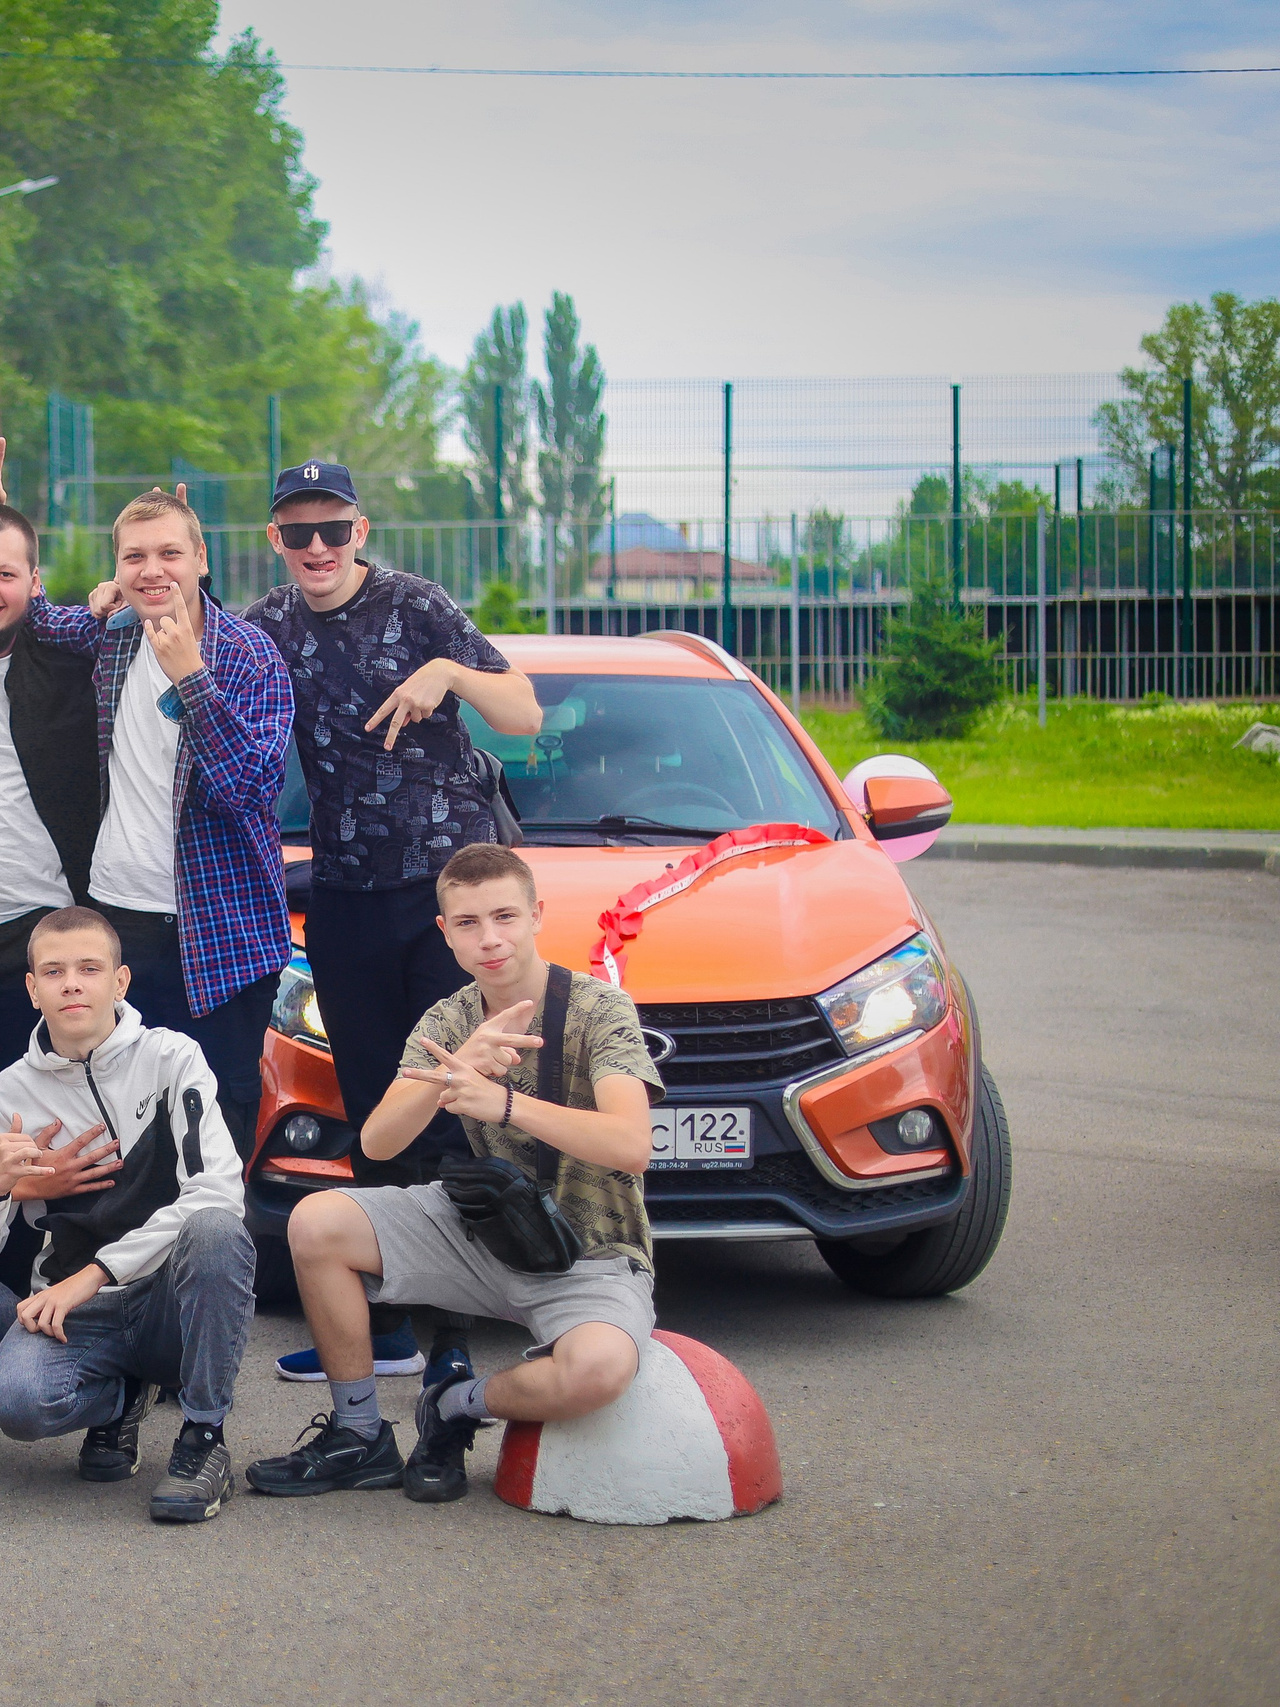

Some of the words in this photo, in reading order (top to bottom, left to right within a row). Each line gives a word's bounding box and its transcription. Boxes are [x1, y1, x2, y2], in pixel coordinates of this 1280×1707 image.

[390, 608, 399, 633] NORTH
[449, 630, 468, 661] NORTH
[464, 638, 477, 657] THE
[402, 847, 411, 869] FACE
[411, 837, 420, 868] NORTH
[420, 851, 428, 868] THE
[609, 1027, 641, 1045] AIR
[680, 1113, 737, 1141] 122
[694, 1142, 723, 1153] RUS
[701, 1161, 742, 1169] ug22.lada.ru
[606, 1170, 636, 1189] AIR
